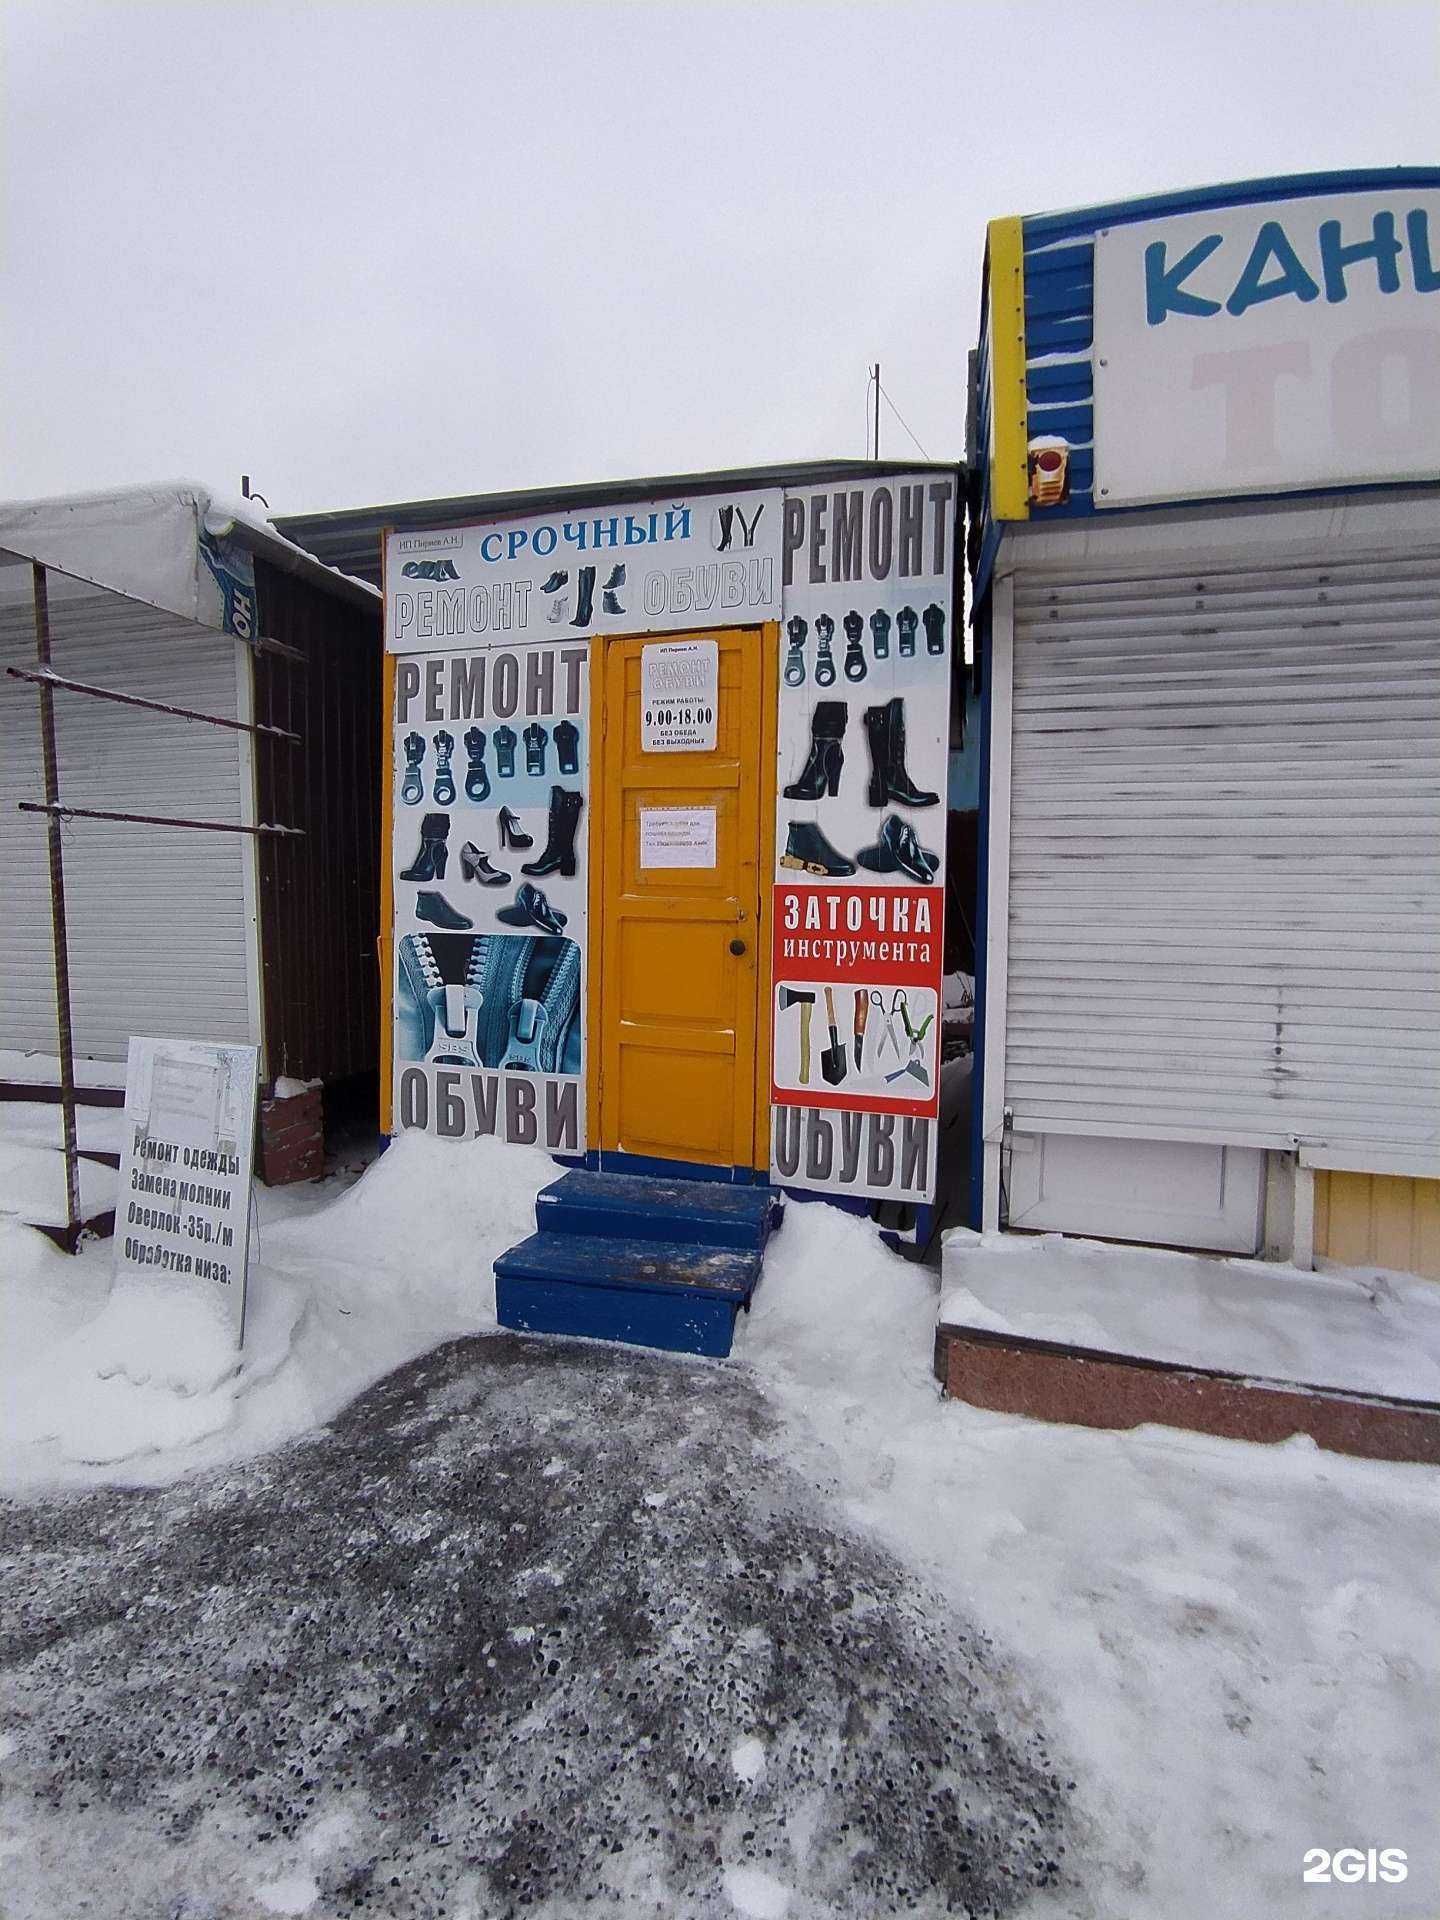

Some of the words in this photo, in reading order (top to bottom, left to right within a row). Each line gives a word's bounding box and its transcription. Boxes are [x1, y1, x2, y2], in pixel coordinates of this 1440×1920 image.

[480, 503, 692, 562] СРОЧНЫЙ
[784, 482, 952, 586] РЕМОНТ
[395, 580, 532, 639] РЕМОНТ
[643, 557, 773, 616] ОБУВИ
[398, 649, 588, 724] РЕМОНТ
[649, 658, 711, 677] РЕМОНТ
[646, 707, 712, 726] 9.00-18.00
[666, 738, 705, 746] ВЫХОДНЫХ
[784, 895, 931, 933] ЗАТОЧКА
[784, 937, 930, 967] инструмента
[401, 1067, 578, 1150] ОБУВИ
[133, 1135, 179, 1163] Ремонт
[183, 1147, 240, 1177] одежды
[131, 1168, 177, 1198] Замена
[179, 1181, 231, 1210] молнии
[127, 1201, 180, 1234] Оверлок
[125, 1237, 192, 1272] Обработка
[195, 1257, 231, 1285] низа:
